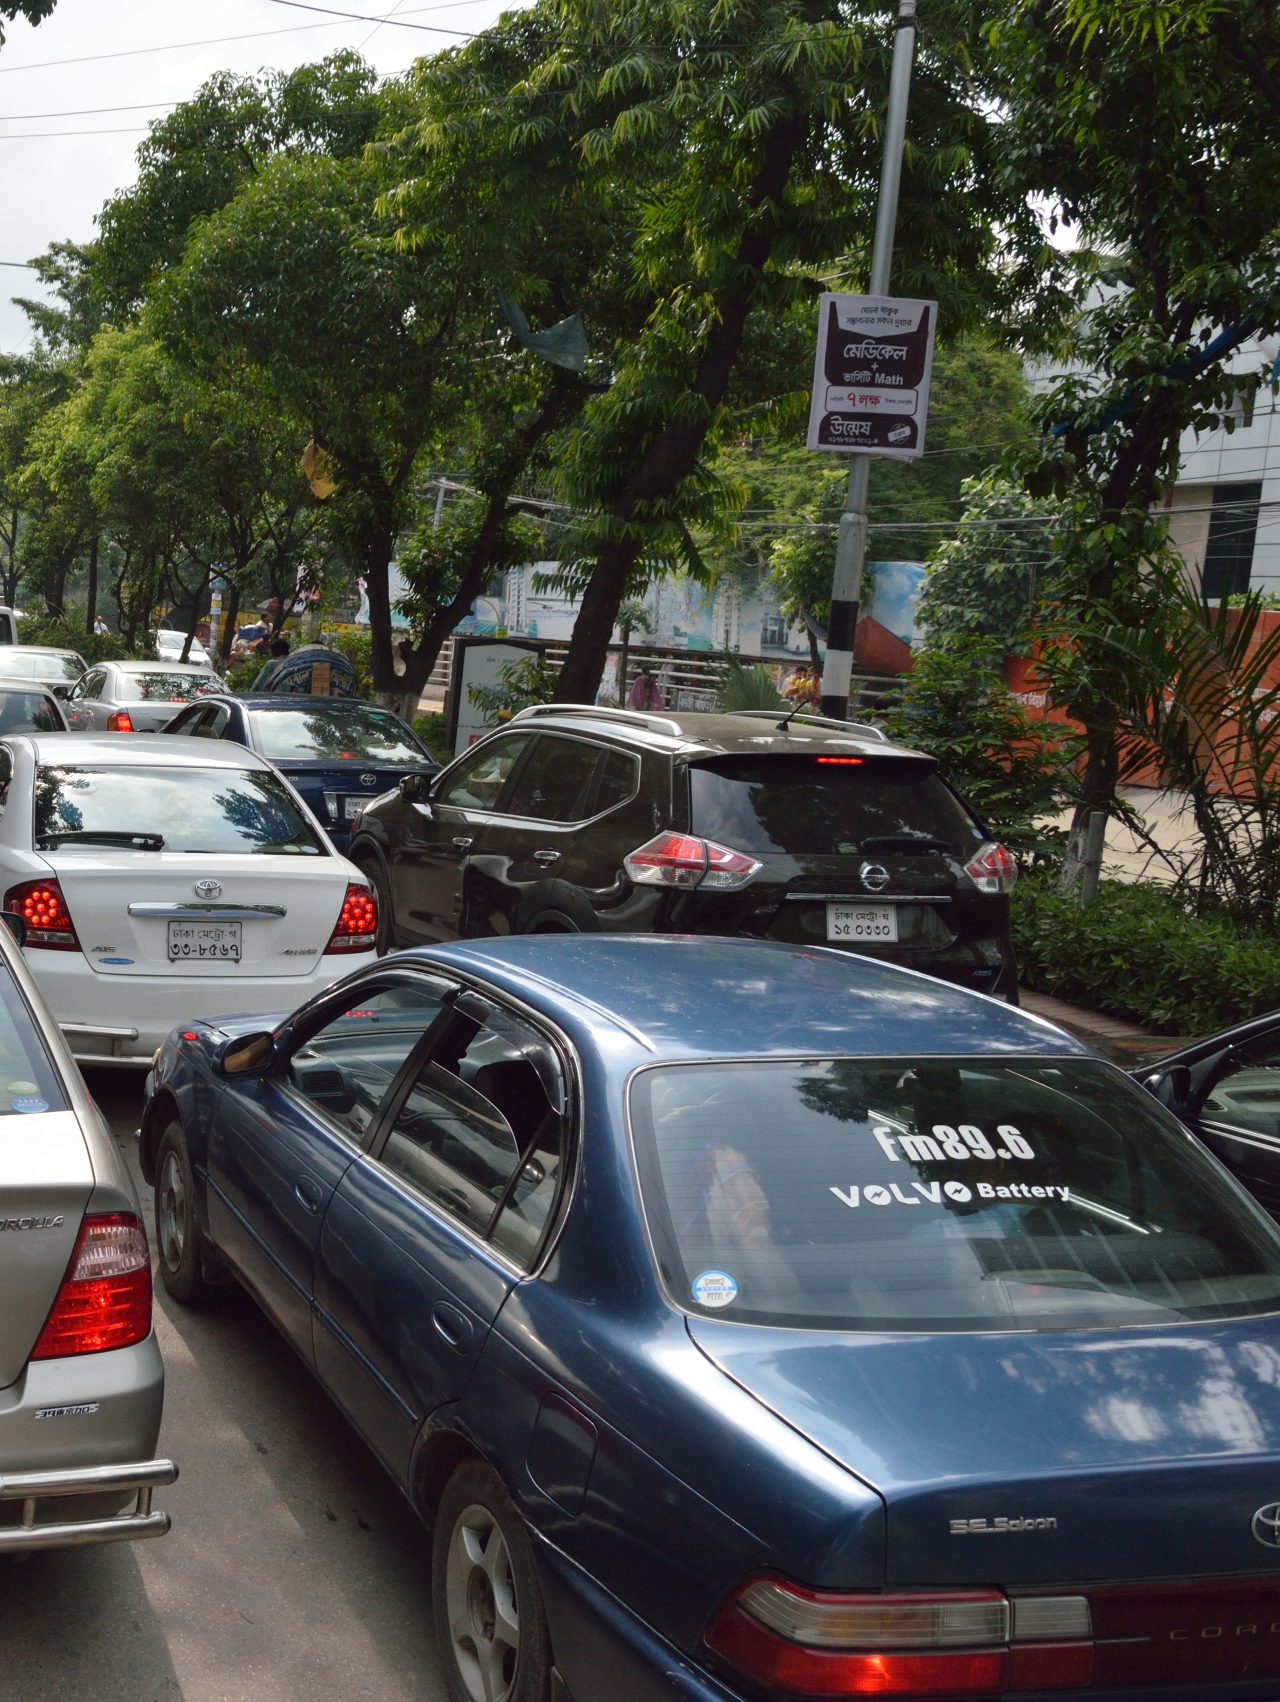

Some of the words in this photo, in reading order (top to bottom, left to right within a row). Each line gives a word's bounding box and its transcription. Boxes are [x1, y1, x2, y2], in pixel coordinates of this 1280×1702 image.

[843, 339, 908, 361] মেডিকেল
[843, 370, 872, 383] ভার্সিটি
[874, 373, 904, 386] Math
[858, 395, 882, 407] লক্ষ
[830, 415, 873, 436] উন্মেষ
[834, 911, 854, 921] ঢাকা
[173, 929, 195, 939] ঢাকা
[834, 923, 891, 936] ১৫-০৩৩০
[170, 943, 240, 957] ৩৩-৮৫৬৭
[872, 1124, 1036, 1163] Fm89.6
[828, 1180, 973, 1209] VOLVO
[977, 1182, 1072, 1203] Battery
